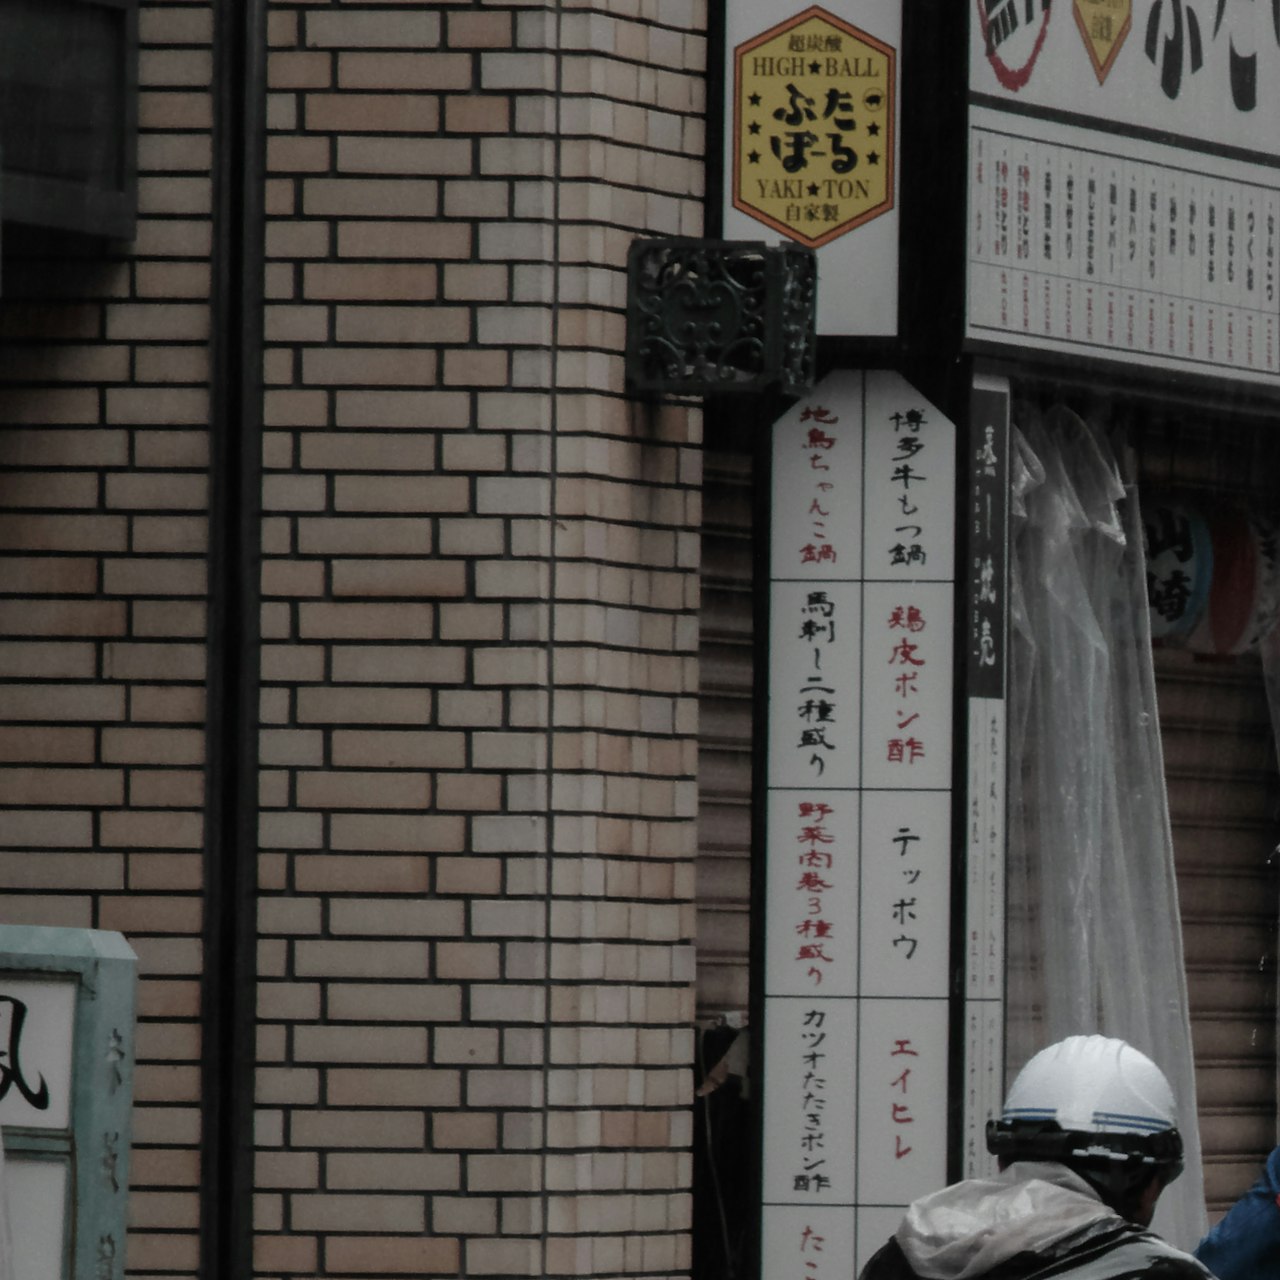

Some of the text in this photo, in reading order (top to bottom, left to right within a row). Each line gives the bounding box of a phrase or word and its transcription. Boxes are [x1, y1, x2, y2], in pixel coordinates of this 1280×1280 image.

[753, 57, 879, 77] HIGH BALL
[757, 179, 870, 199] YAKI TON
[785, 203, 840, 222] 自家製
[890, 408, 928, 567] 博多牛もつ鍋
[888, 1037, 920, 1160] エイヒレ
